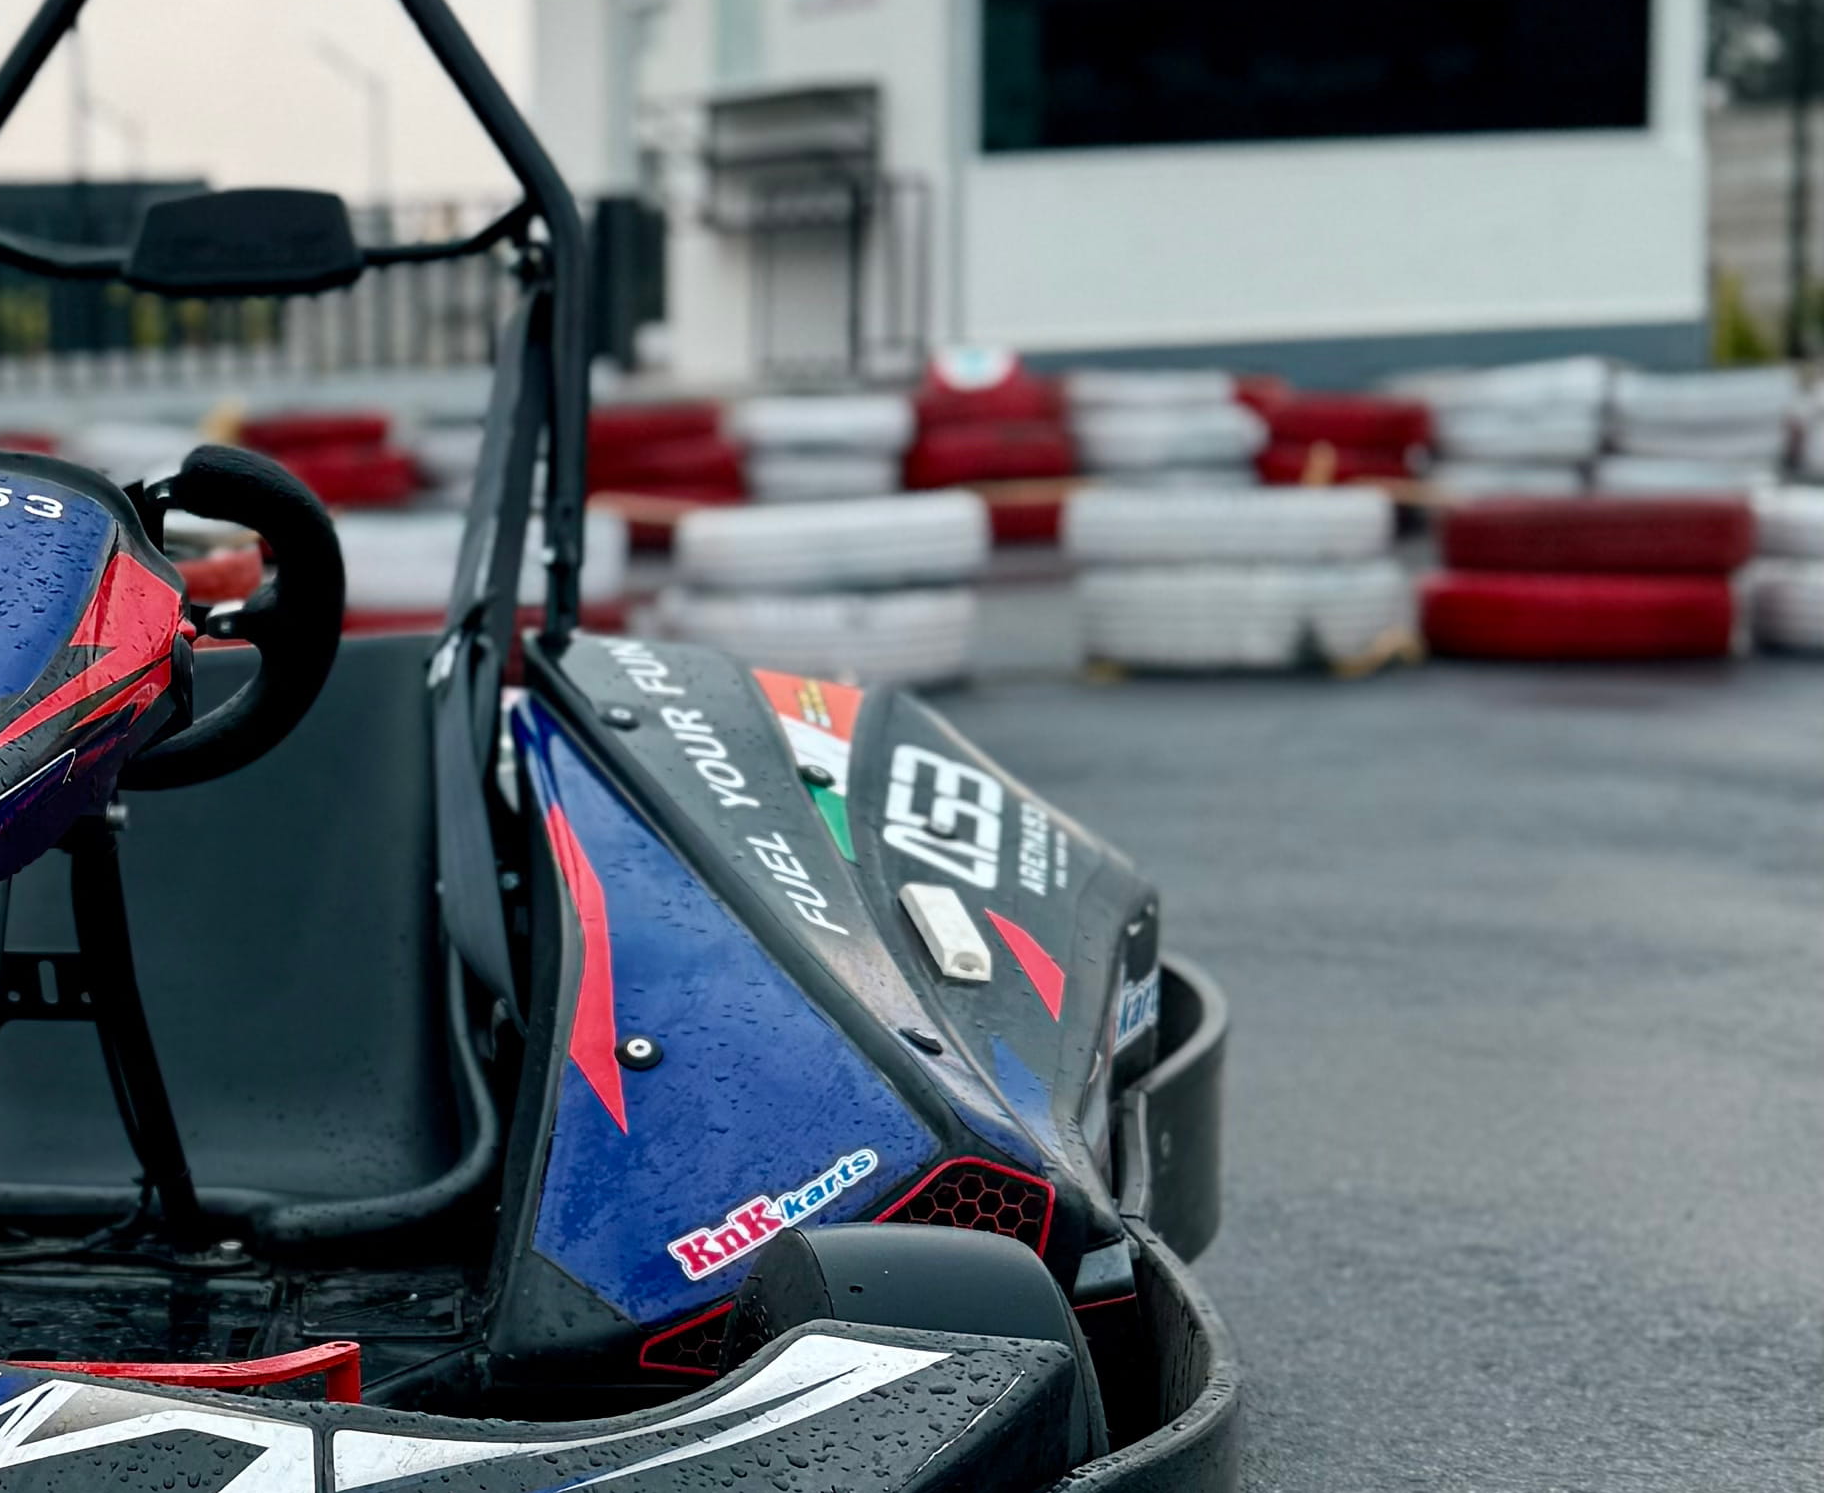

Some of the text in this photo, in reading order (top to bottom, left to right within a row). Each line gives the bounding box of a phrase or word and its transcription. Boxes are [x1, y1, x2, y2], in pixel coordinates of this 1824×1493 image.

[599, 639, 849, 935] FUEL YOUR FUN
[676, 1153, 871, 1274] KnK karts
